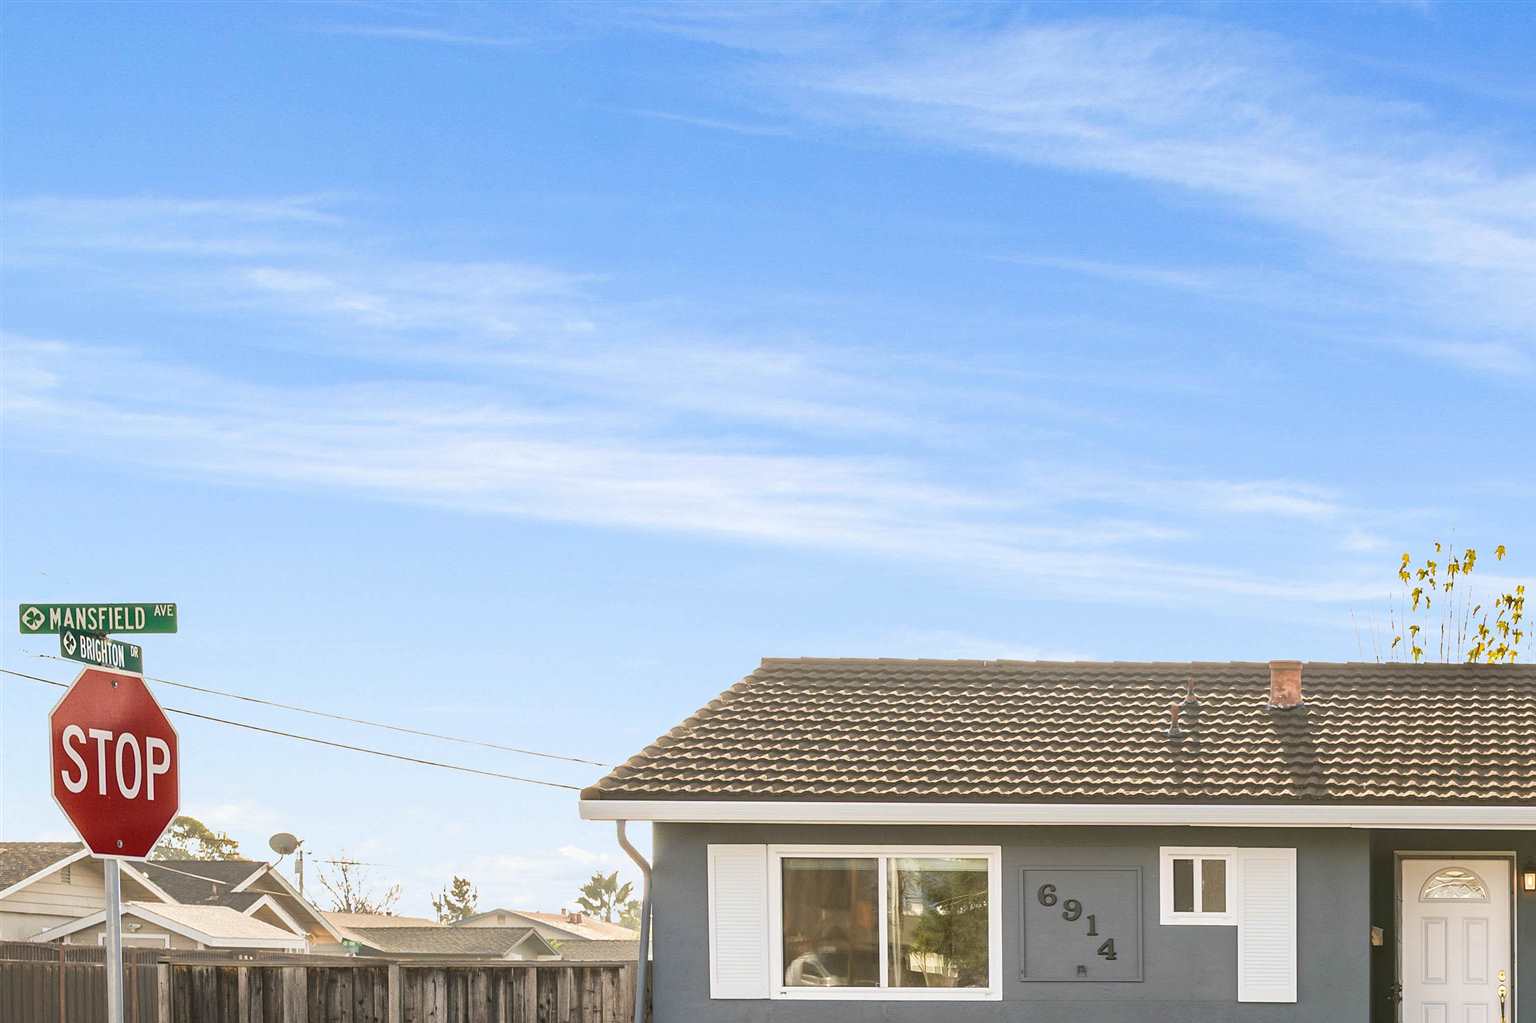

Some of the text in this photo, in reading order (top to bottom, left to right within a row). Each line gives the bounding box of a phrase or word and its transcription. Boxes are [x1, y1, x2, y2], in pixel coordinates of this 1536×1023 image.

[50, 604, 174, 631] MANSFIELD AVE
[79, 635, 139, 668] BRIGHTON DR
[61, 724, 171, 801] STOP
[1037, 883, 1118, 961] 6914
